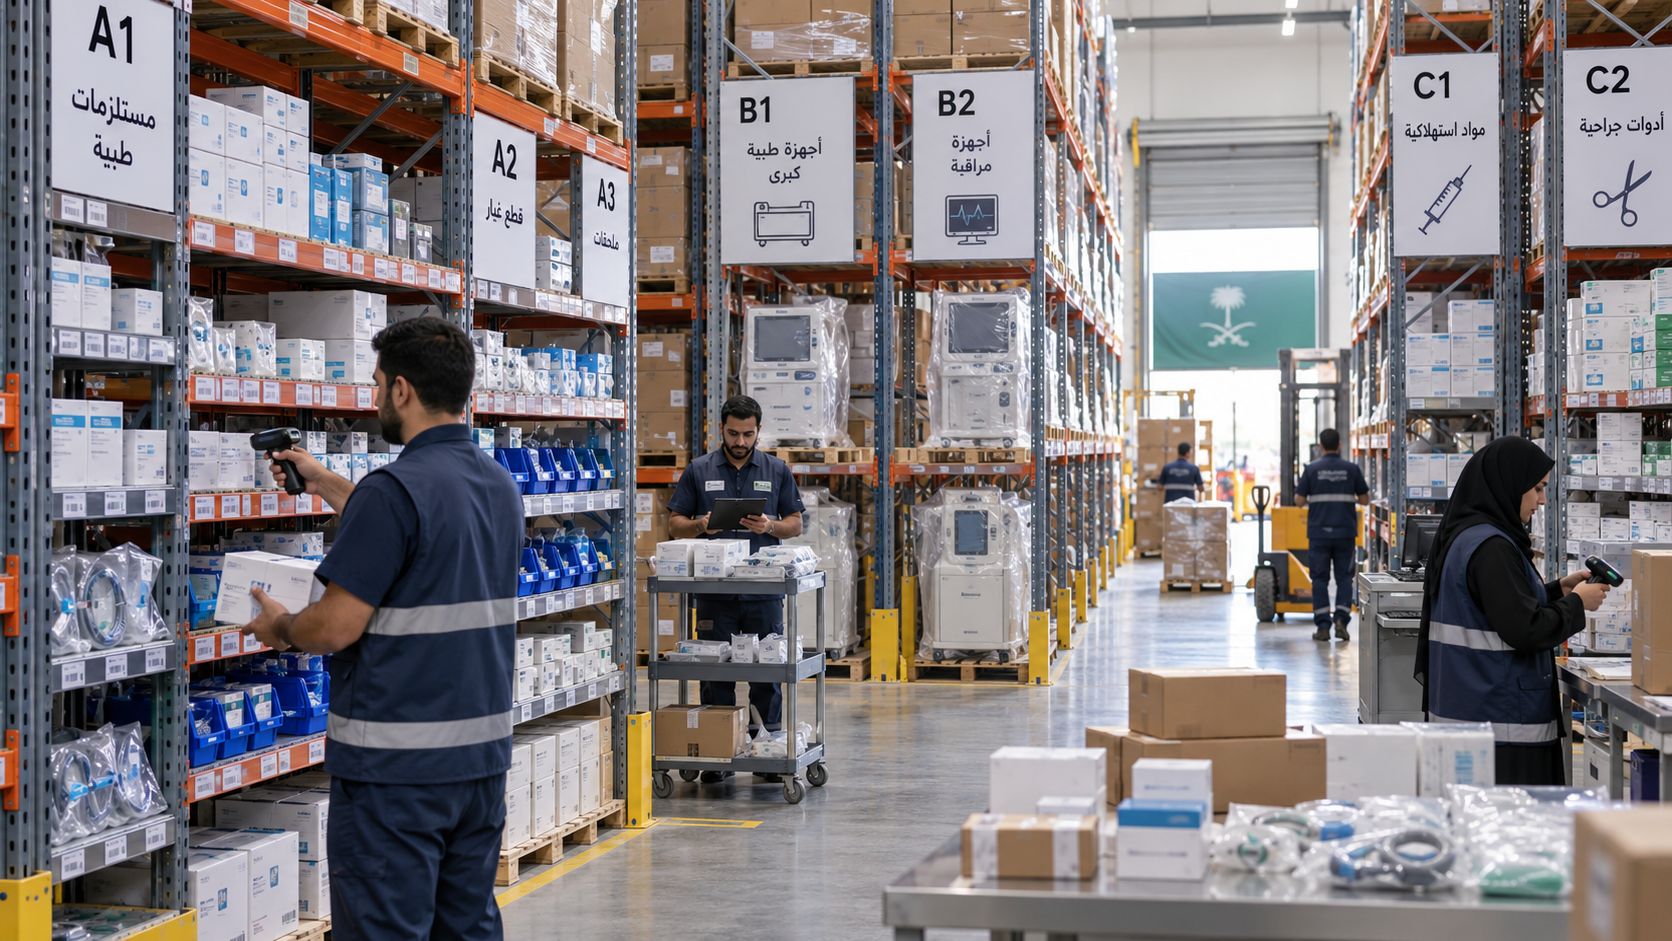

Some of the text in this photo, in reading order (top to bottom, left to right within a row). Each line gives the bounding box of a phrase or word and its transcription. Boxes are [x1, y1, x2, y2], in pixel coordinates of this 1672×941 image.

[88, 5, 132, 64] A1
[1414, 71, 1450, 99] C1
[1586, 65, 1630, 94] C2
[72, 88, 155, 130] مستلزمات
[740, 96, 770, 123] B1
[938, 89, 975, 116] B2
[1405, 121, 1486, 142] مواد استهلاكية
[1579, 111, 1665, 137] أدوات جراحية
[93, 134, 132, 170] طبية
[747, 136, 822, 160] أجهزة طبية
[951, 128, 990, 151] أجهزة
[492, 139, 517, 180] A2
[769, 166, 801, 184] كبرى
[597, 178, 615, 211] A3
[485, 198, 523, 229] قطع غيار
